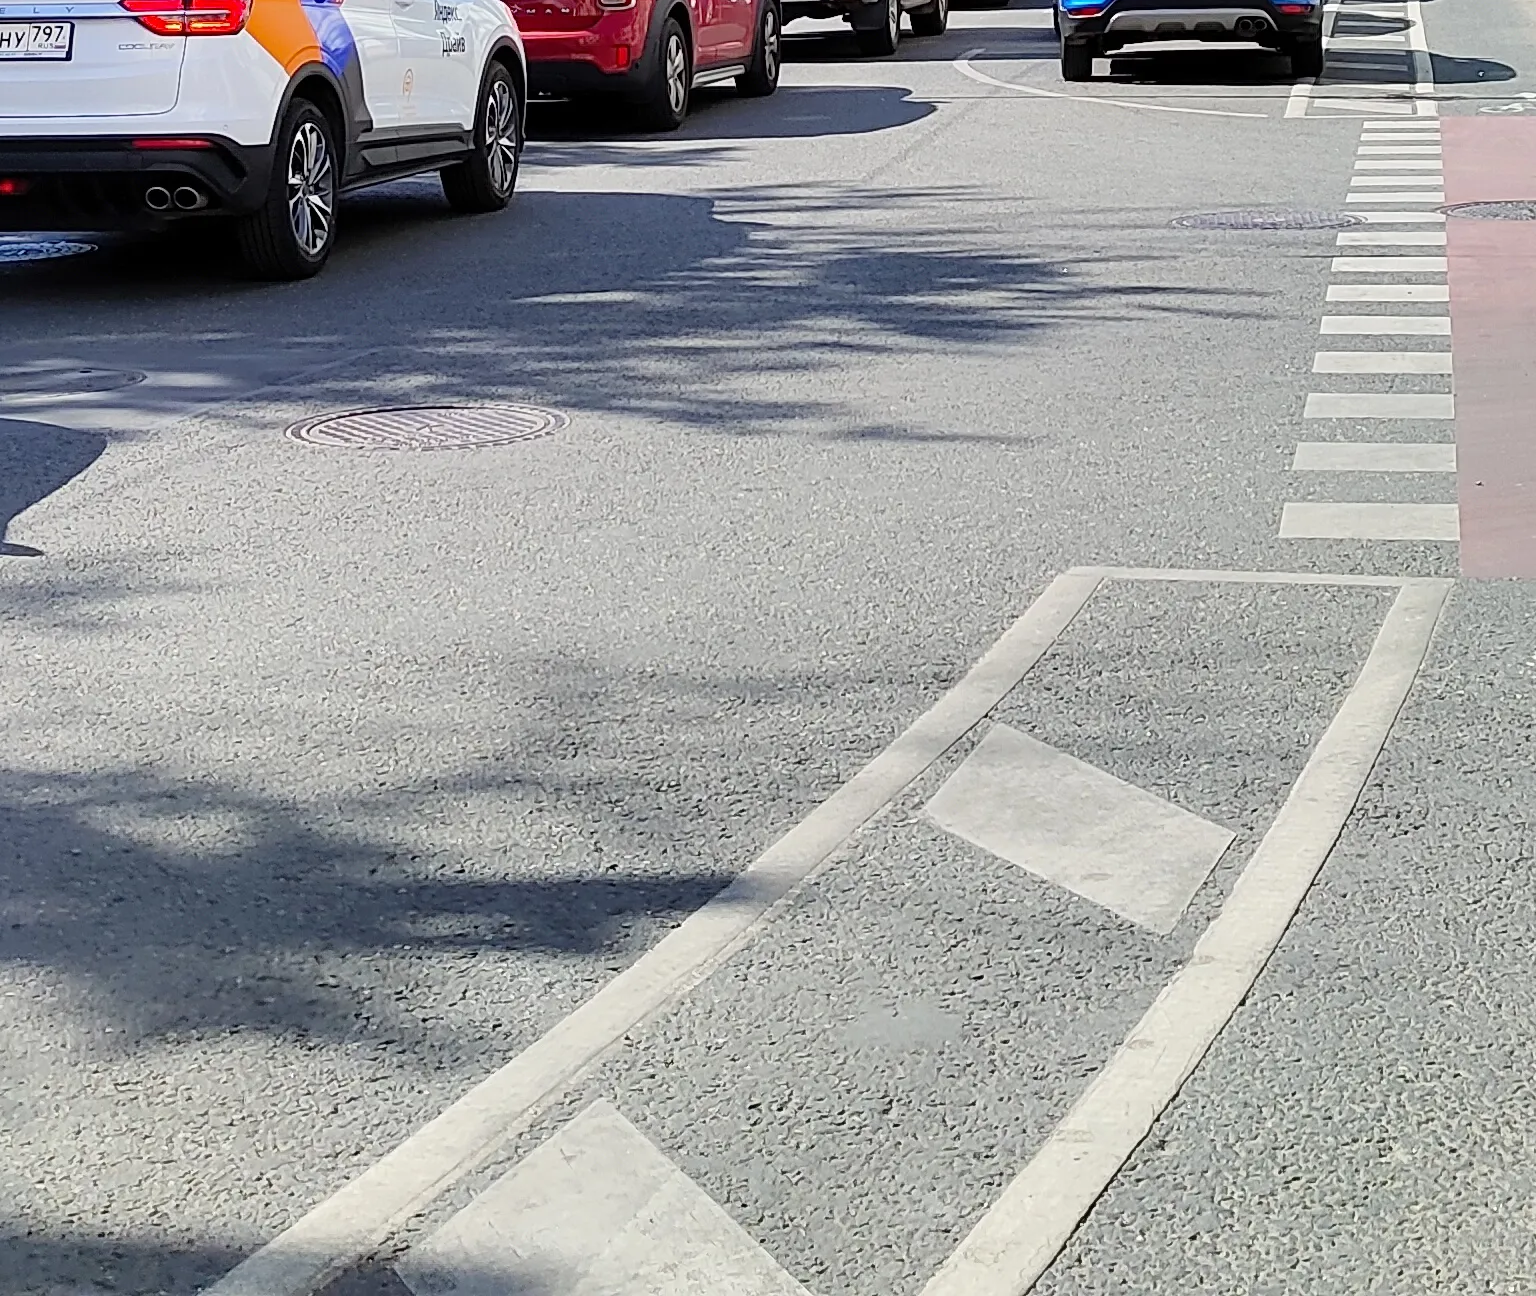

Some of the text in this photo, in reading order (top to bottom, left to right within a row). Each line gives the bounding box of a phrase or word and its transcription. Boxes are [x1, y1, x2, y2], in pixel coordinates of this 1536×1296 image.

[31, 25, 65, 43] 797
[37, 42, 54, 50] RUS
[440, 31, 466, 58] Драйв
